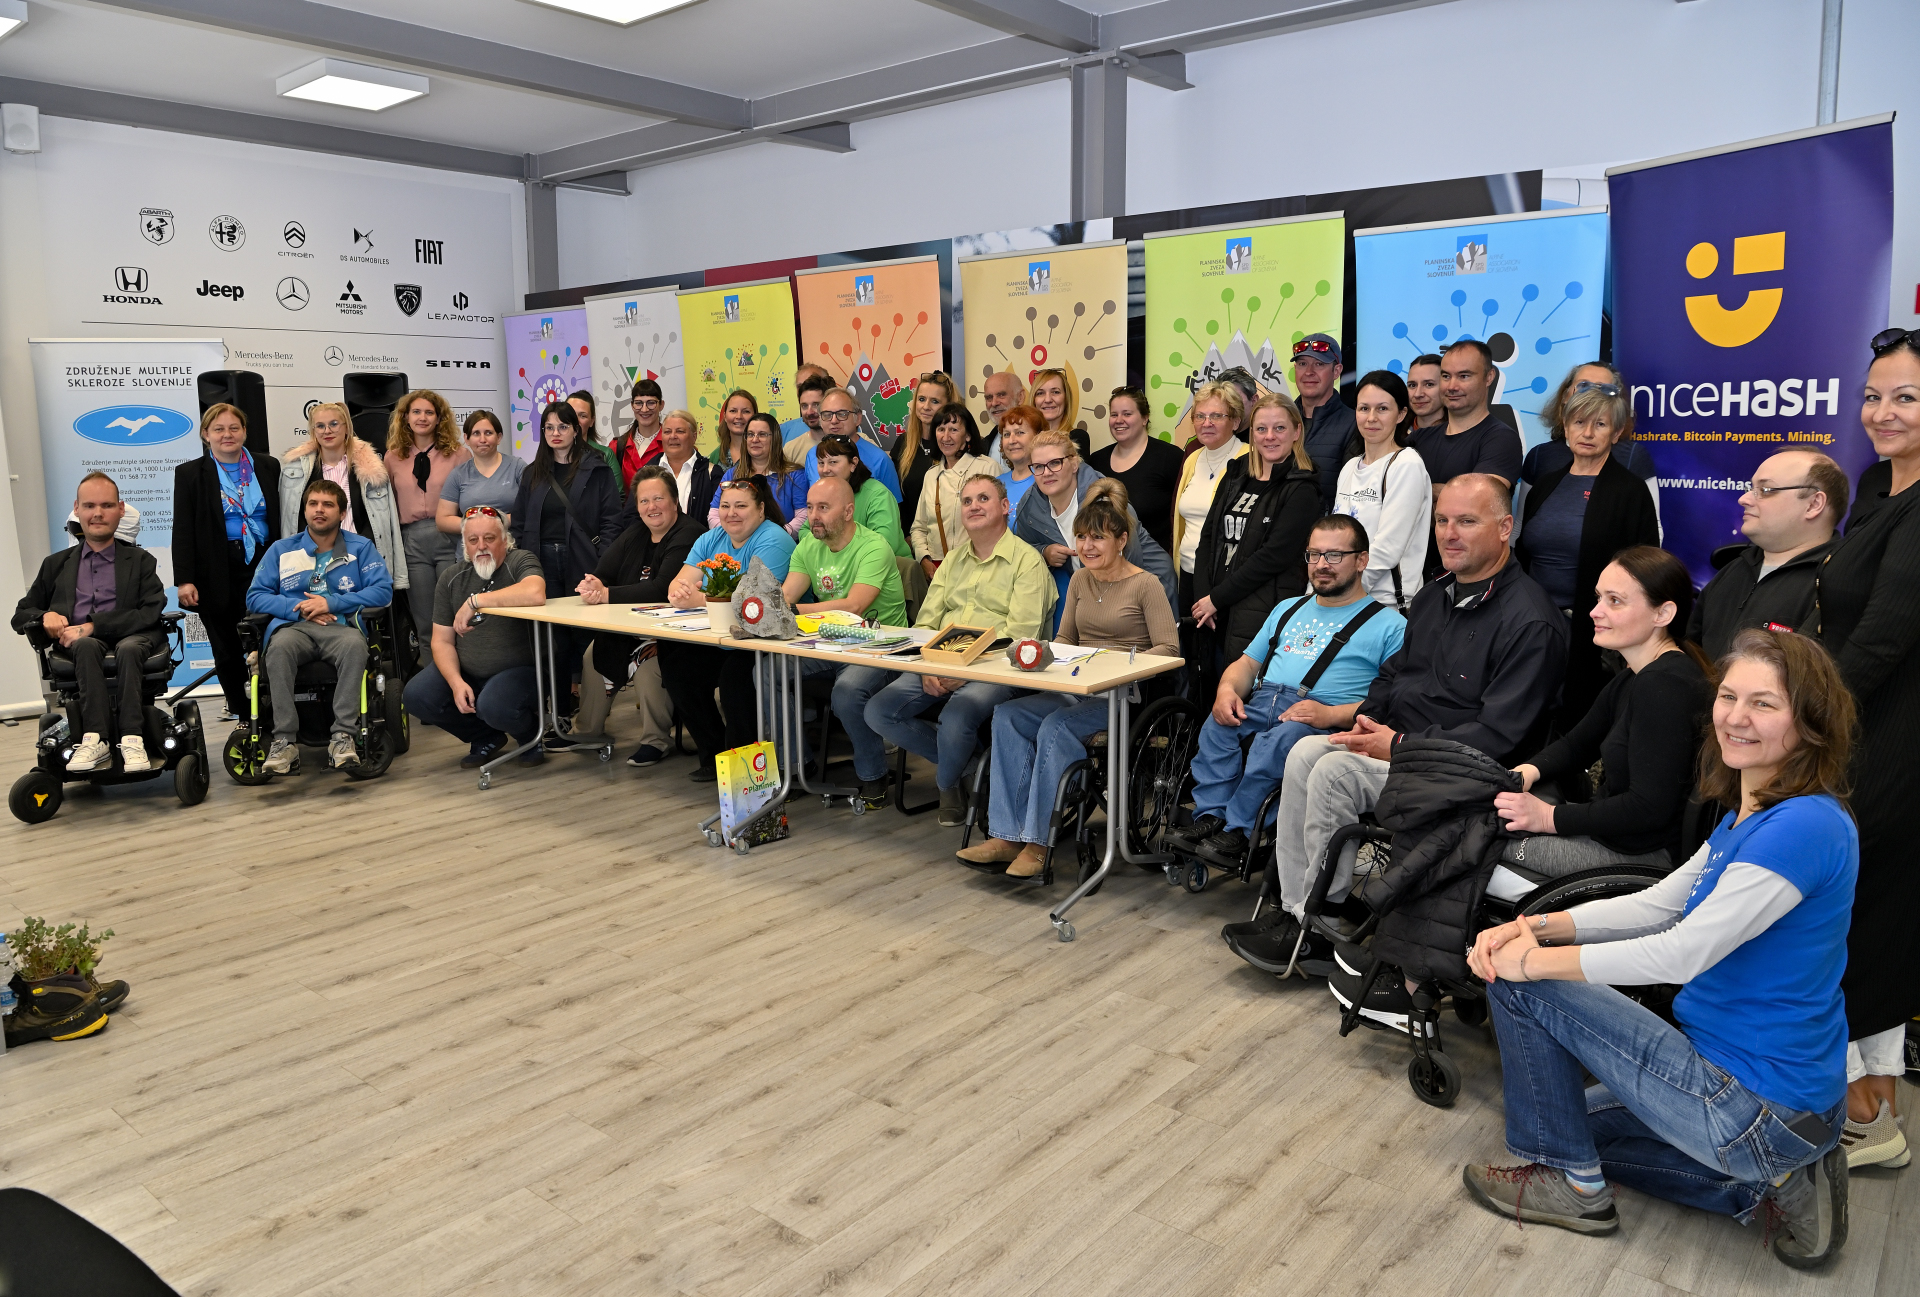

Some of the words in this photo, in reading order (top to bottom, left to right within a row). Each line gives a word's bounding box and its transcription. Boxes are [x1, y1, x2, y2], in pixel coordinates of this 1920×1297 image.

[142, 209, 171, 217] ABARTH
[414, 238, 444, 265] FIAT
[339, 254, 348, 262] DS
[349, 255, 390, 265] AUTOMOBILES
[1200, 258, 1225, 266] PLANINSKA
[1425, 257, 1455, 265] PLANINSKA
[1427, 270, 1455, 278] SLOVENIJE
[196, 279, 244, 301] Jeep
[102, 294, 163, 305] HONDA
[335, 302, 367, 310] MITSUBISHI
[427, 312, 495, 323] LEAPMOTOR
[234, 350, 294, 360] Mercedes-Benz
[348, 354, 399, 363] Mercedes-Benz
[425, 359, 491, 368] SETRA
[66, 364, 131, 376] ZDRUŽENJE
[138, 366, 193, 375] MULTIPLE
[67, 378, 125, 387] SKLEROZE
[132, 377, 192, 387] SLOVENIJE
[1629, 431, 1681, 442] Hashrate.
[1684, 431, 1722, 442] Bitcoin
[1724, 431, 1784, 445] Payments.
[1787, 431, 1836, 445] Mining.
[82, 459, 111, 467] Združenje
[1232, 492, 1259, 513] EE
[756, 775, 764, 783] 10
